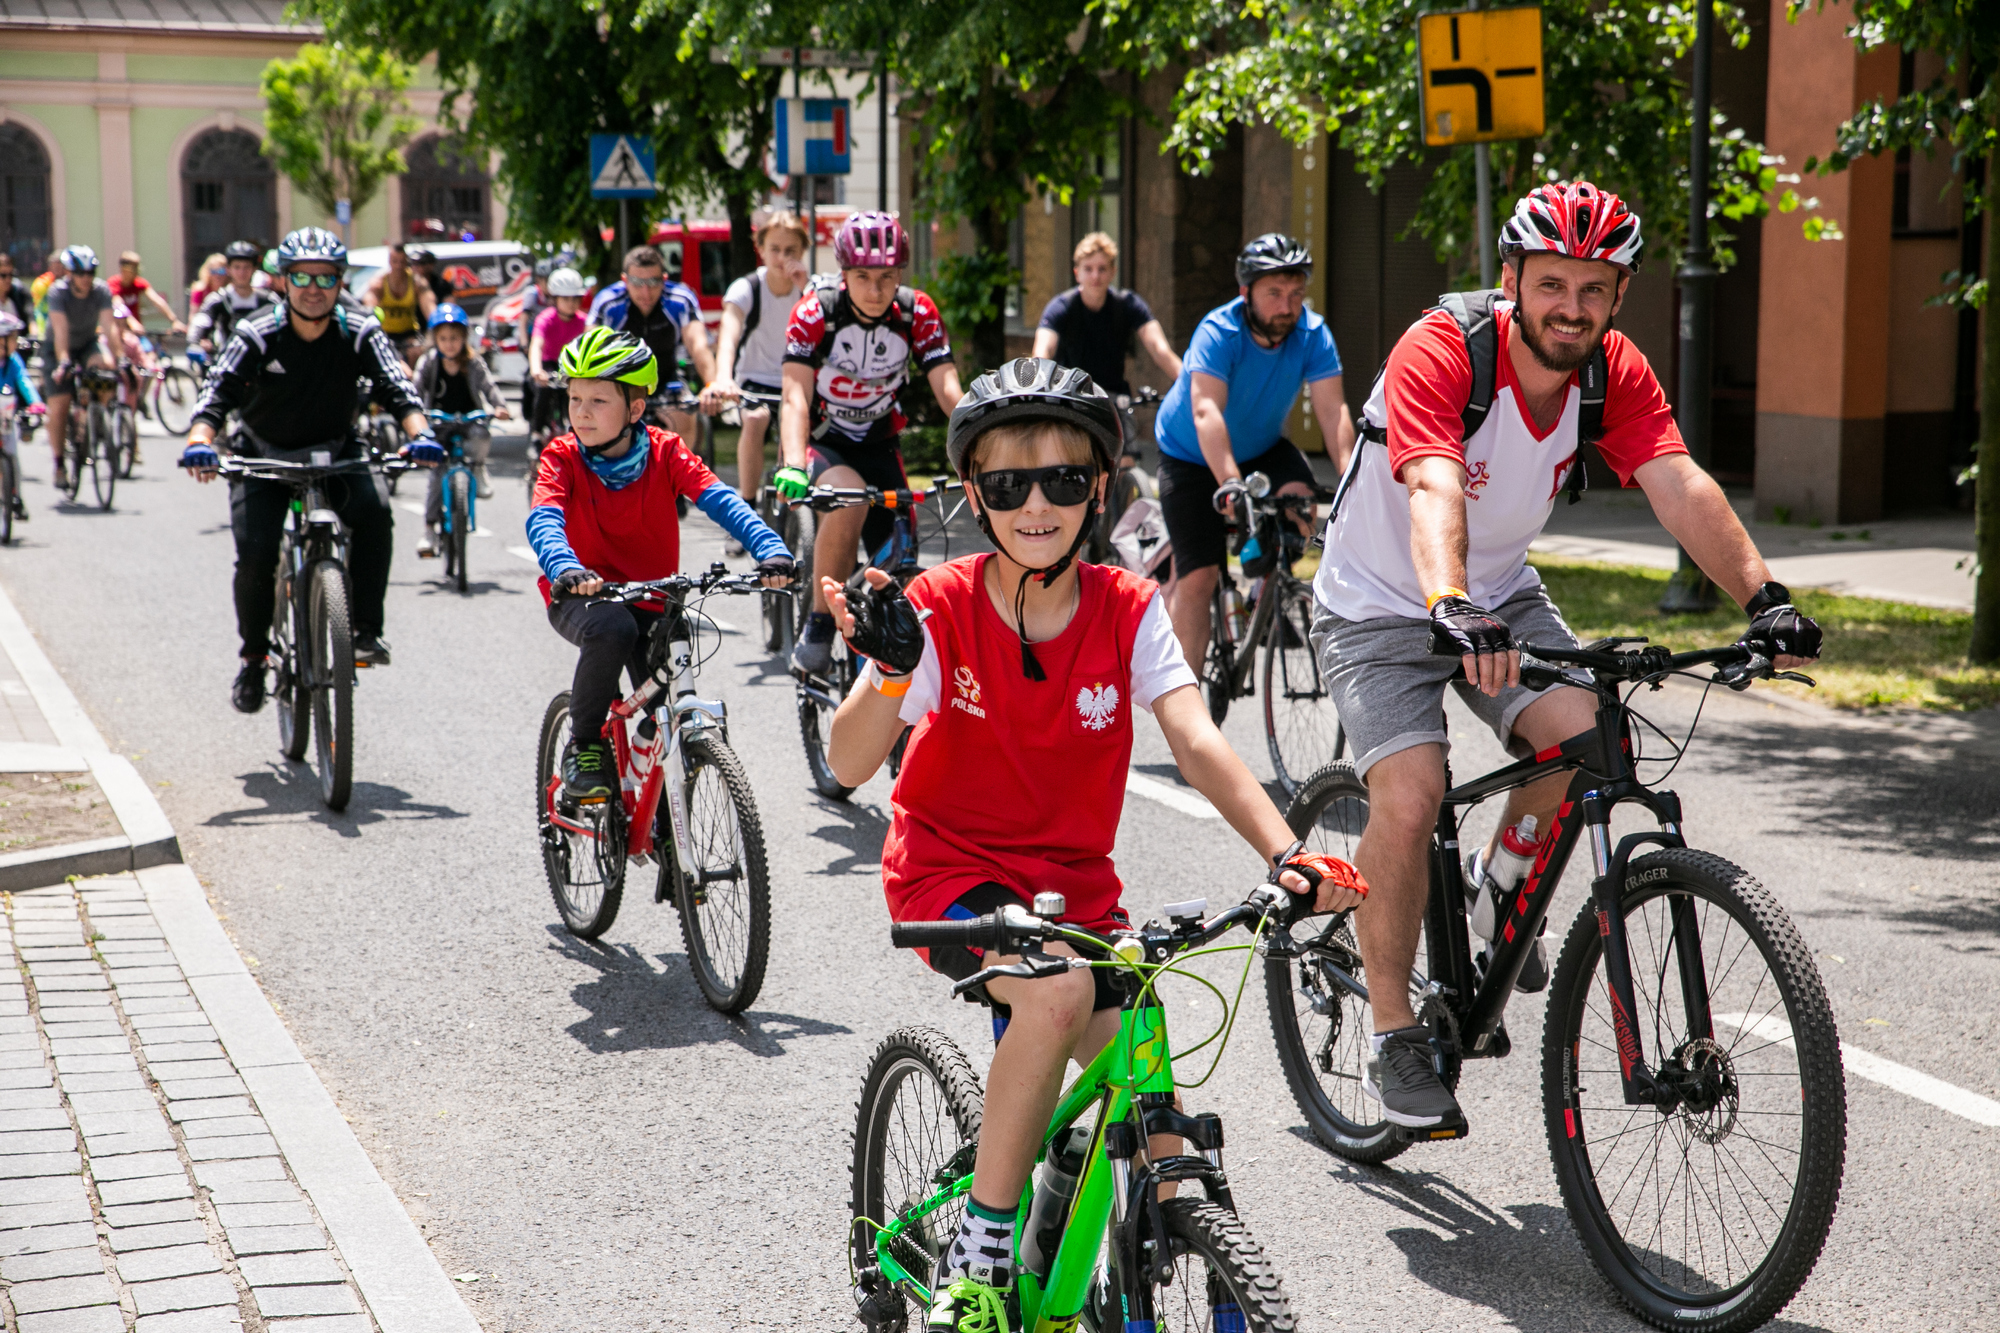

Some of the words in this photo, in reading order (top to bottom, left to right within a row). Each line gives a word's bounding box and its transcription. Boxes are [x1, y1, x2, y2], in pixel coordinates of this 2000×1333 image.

[951, 698, 986, 719] POLSKA
[1306, 775, 1345, 801] BONTRAGER
[1624, 867, 1669, 892] TRAGER
[1147, 934, 1170, 942] CUBE
[1562, 1047, 1571, 1100] CONNECTION
[907, 1188, 950, 1221] CUBE
